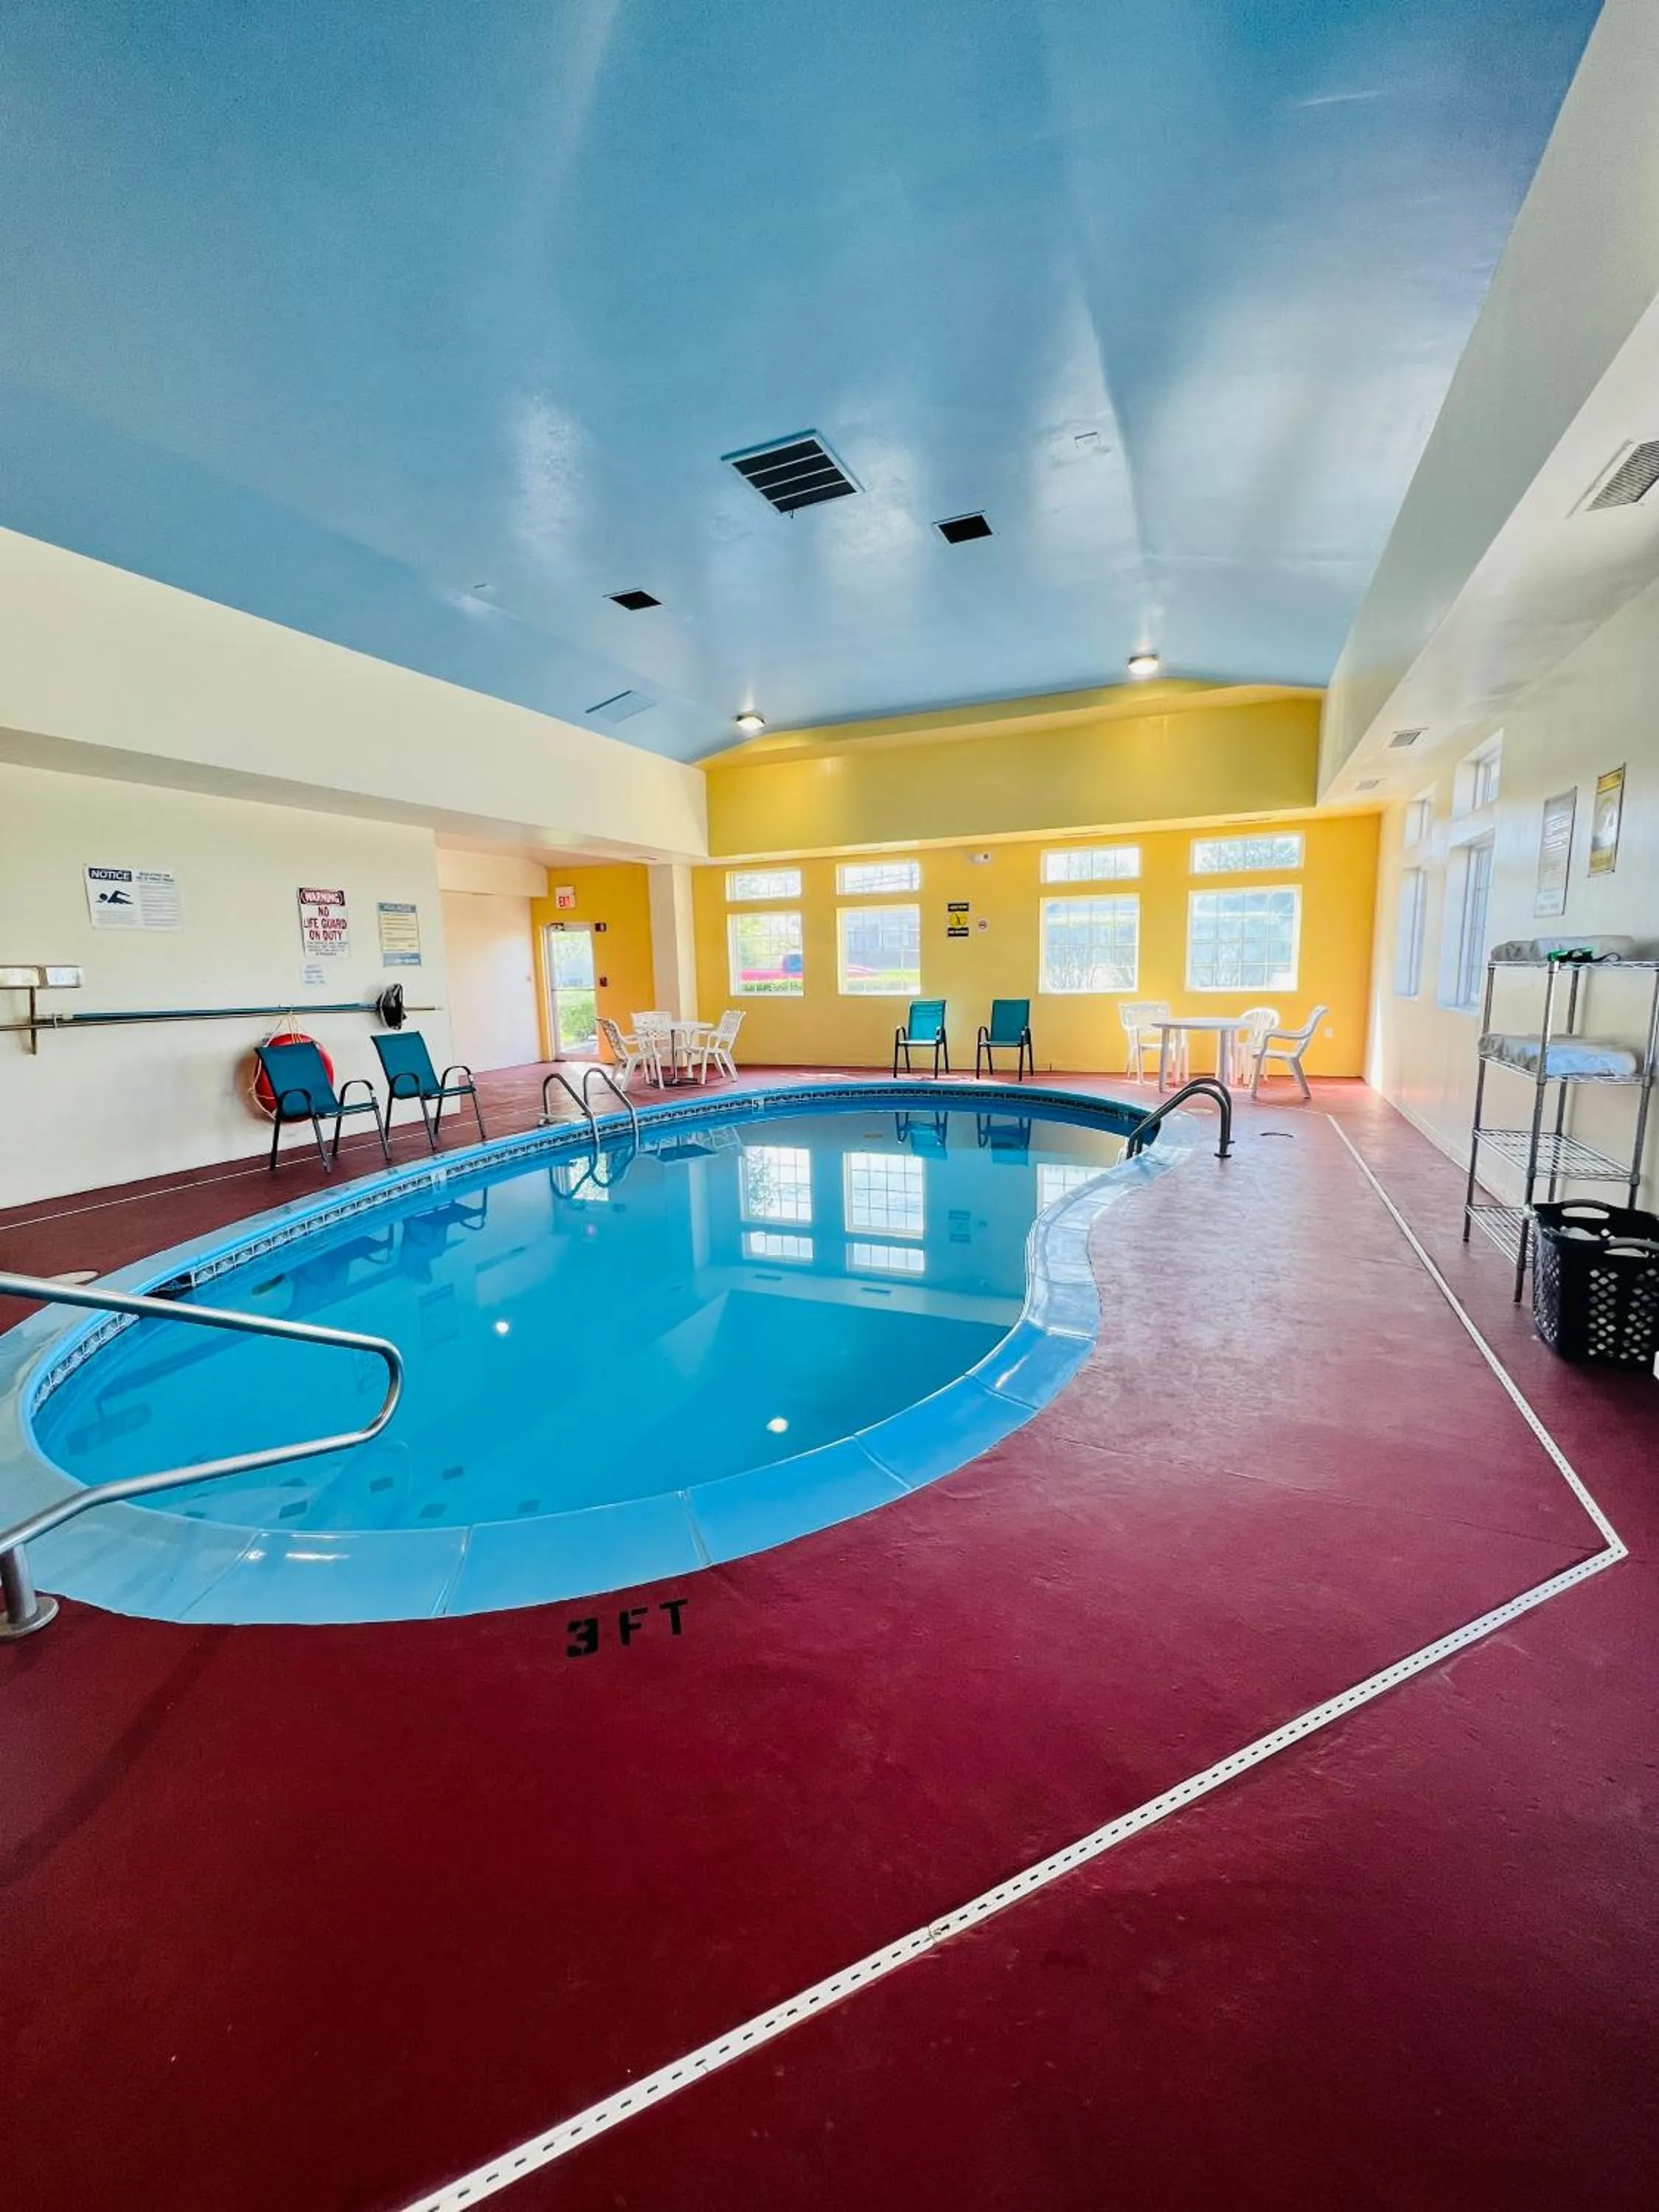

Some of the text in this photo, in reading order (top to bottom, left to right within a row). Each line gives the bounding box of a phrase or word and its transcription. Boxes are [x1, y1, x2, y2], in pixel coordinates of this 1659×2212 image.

[91, 870, 131, 880] NOTICE
[304, 891, 341, 903] WARNING
[318, 906, 330, 917] NO
[303, 918, 347, 929] LIFE GUARD
[309, 930, 343, 941] ON DUTY
[566, 1598, 688, 1658] 3 FT
